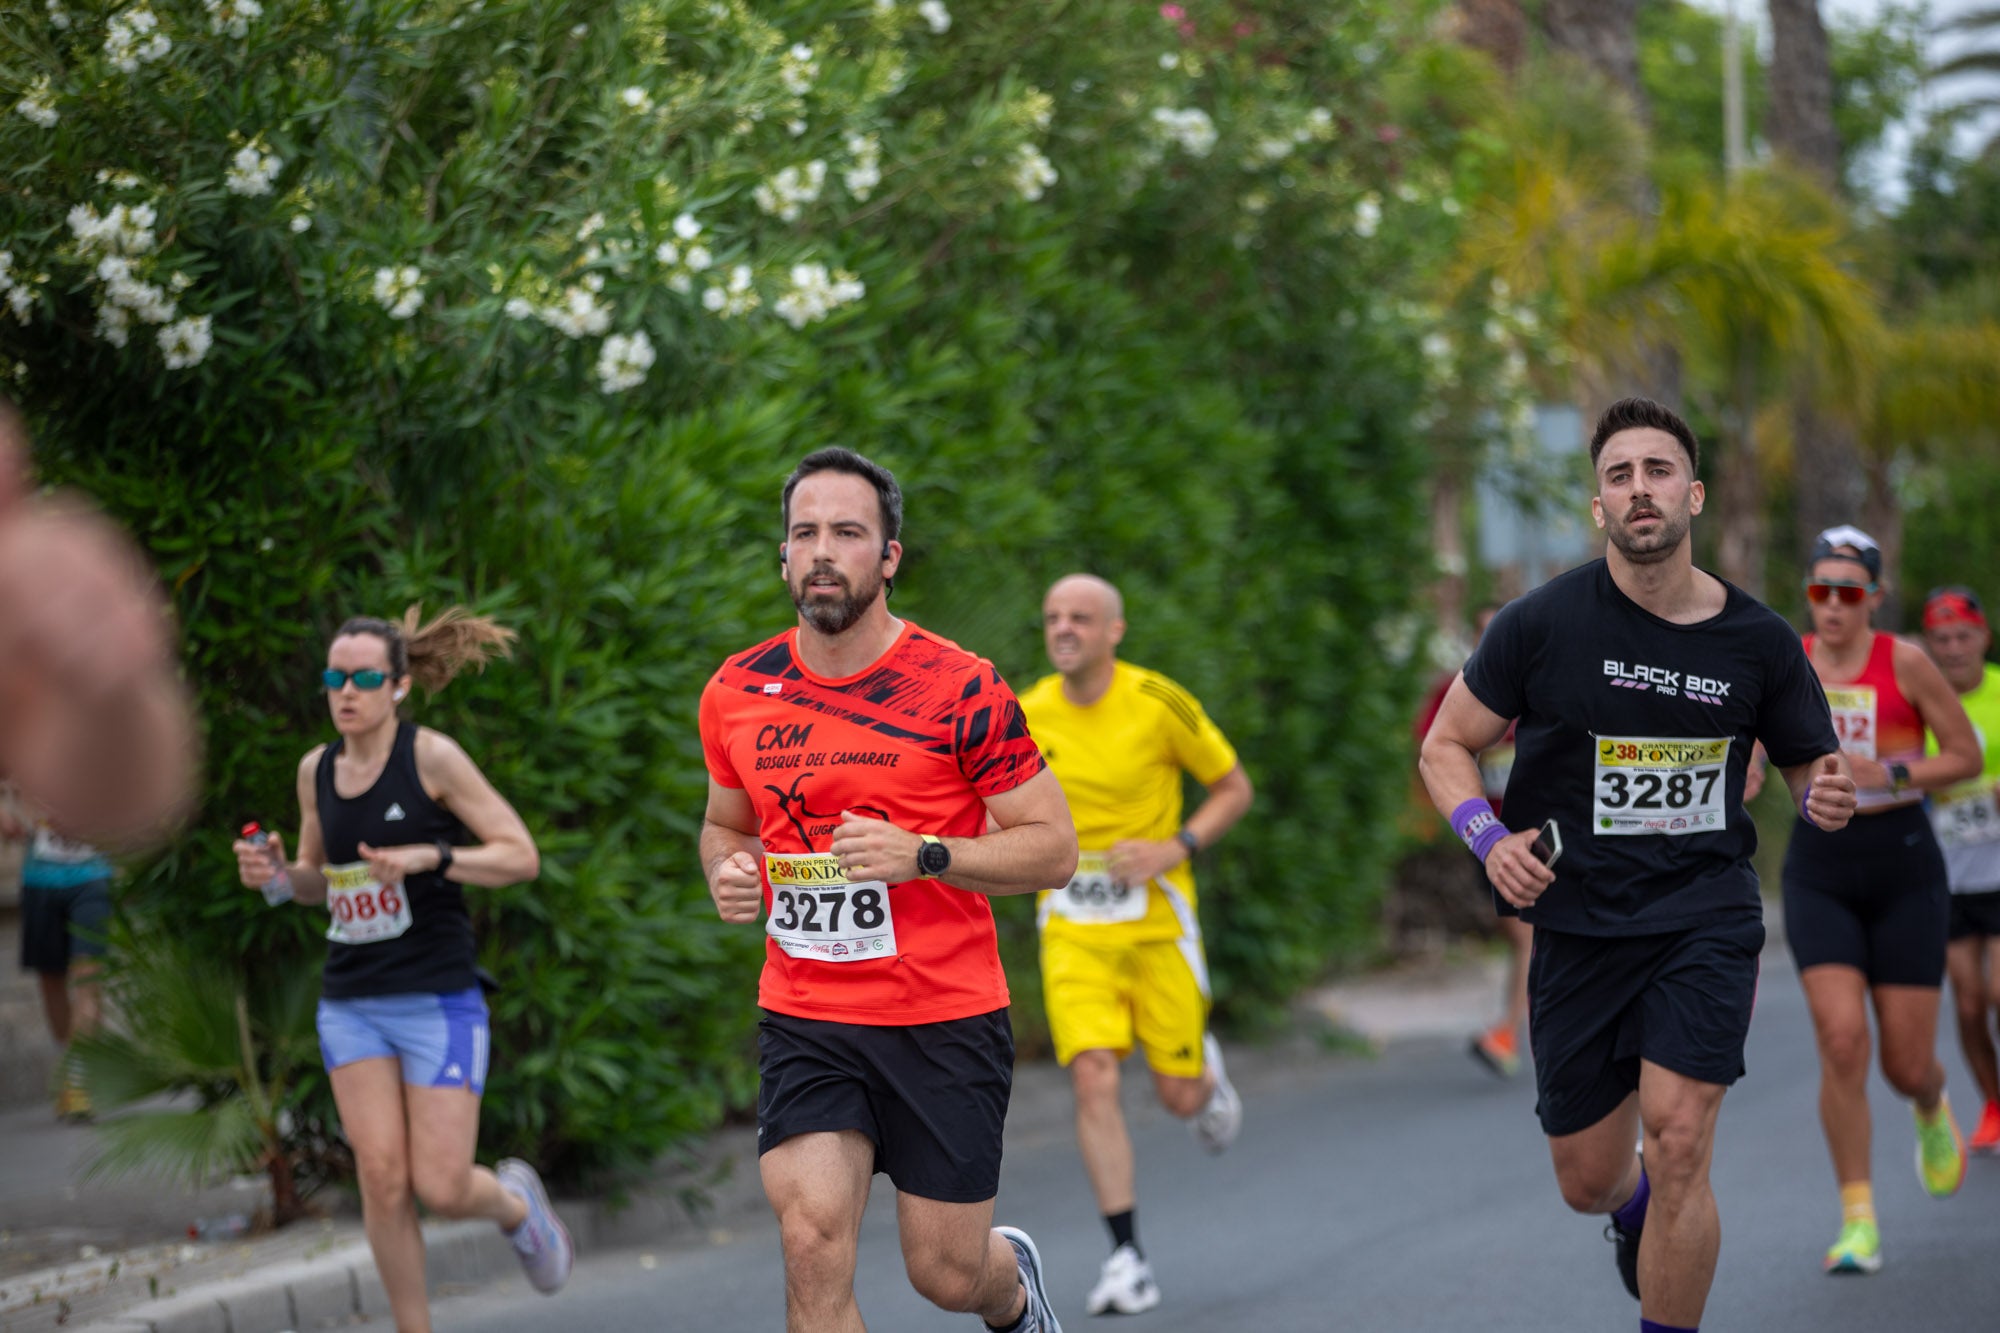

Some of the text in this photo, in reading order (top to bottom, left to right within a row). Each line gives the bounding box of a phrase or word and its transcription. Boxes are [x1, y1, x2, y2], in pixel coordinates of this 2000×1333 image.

[1603, 659, 1732, 697] BLACK BOX
[1656, 684, 1678, 696] PRO
[755, 722, 815, 751] CXM
[755, 751, 901, 771] BOSQUE DEL CAMARATE
[1616, 743, 1638, 761] 38
[1637, 749, 1704, 762] FONDO
[1599, 769, 1721, 810] 3287
[808, 823, 842, 837] LUGR
[776, 860, 795, 878] 38
[813, 858, 839, 866] PREMI
[774, 888, 885, 933] 3278
